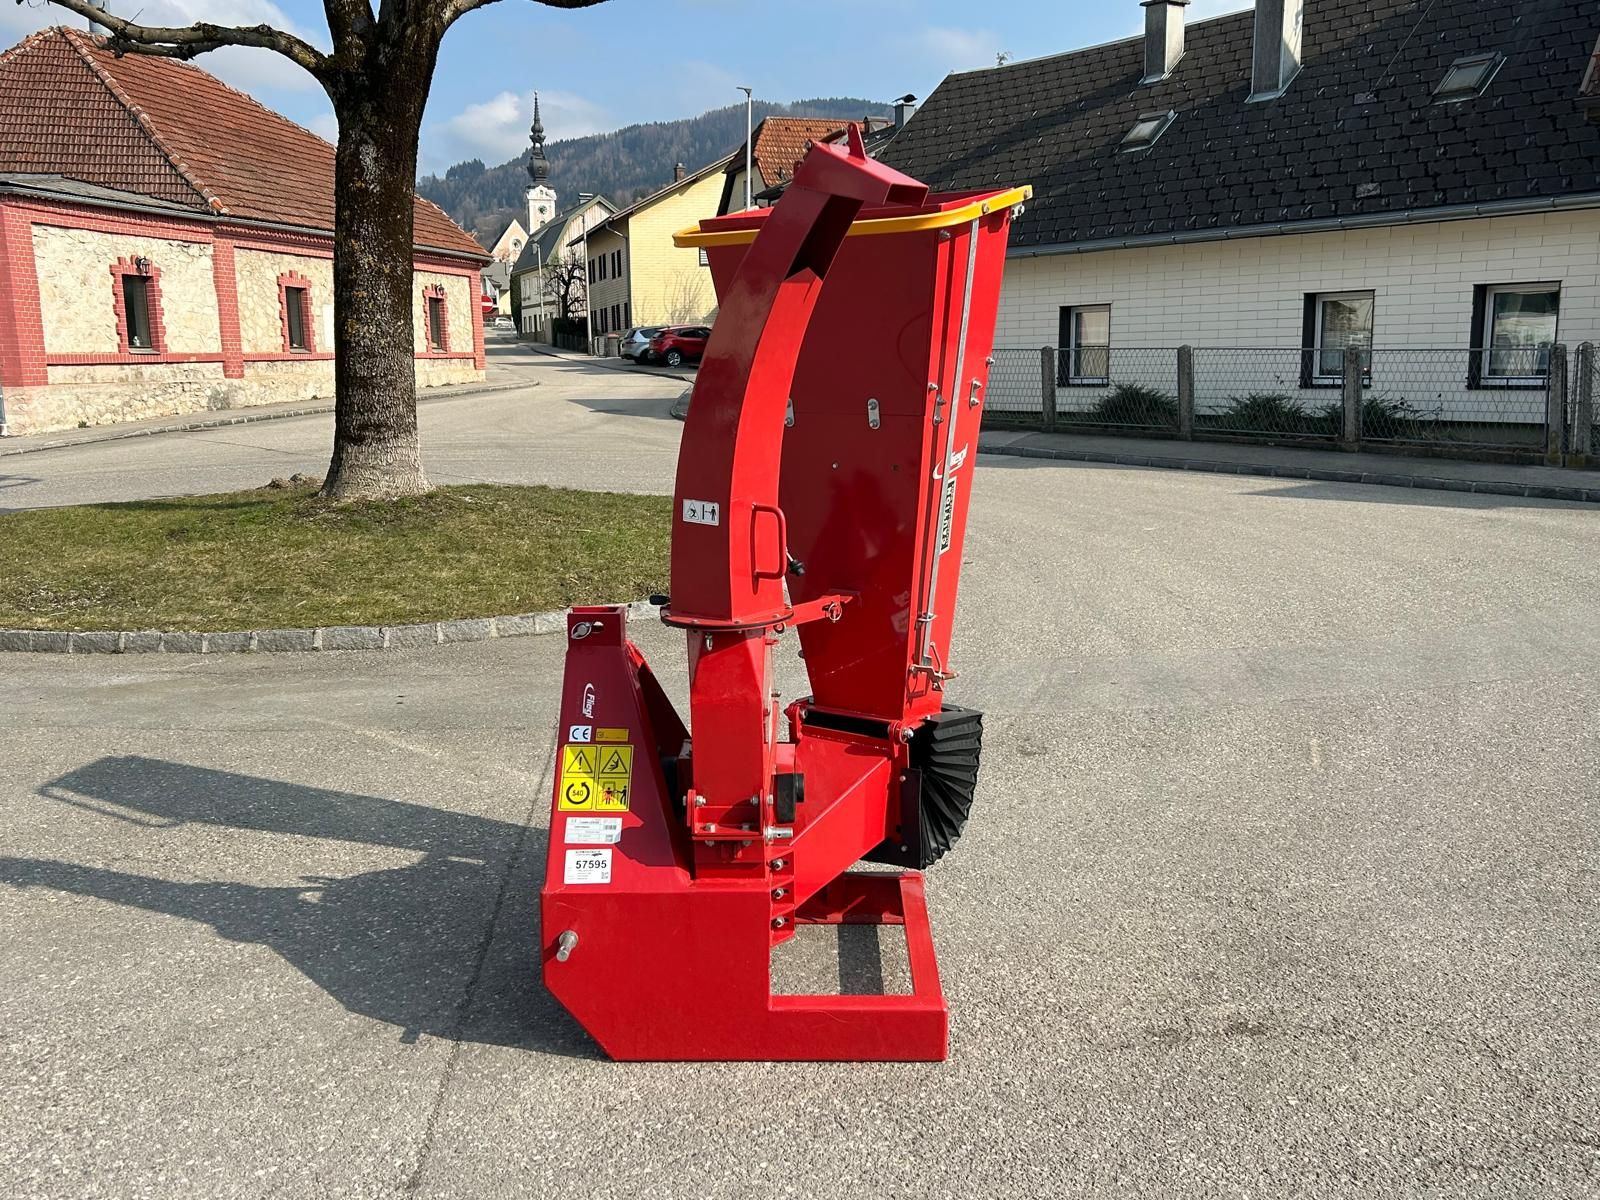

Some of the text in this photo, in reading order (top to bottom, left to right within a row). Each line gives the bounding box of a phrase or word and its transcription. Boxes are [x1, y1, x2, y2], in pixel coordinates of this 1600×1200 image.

[585, 693, 595, 719] Fliegl
[572, 727, 590, 740] CE
[572, 789, 584, 797] 540
[575, 859, 607, 870] 57595
